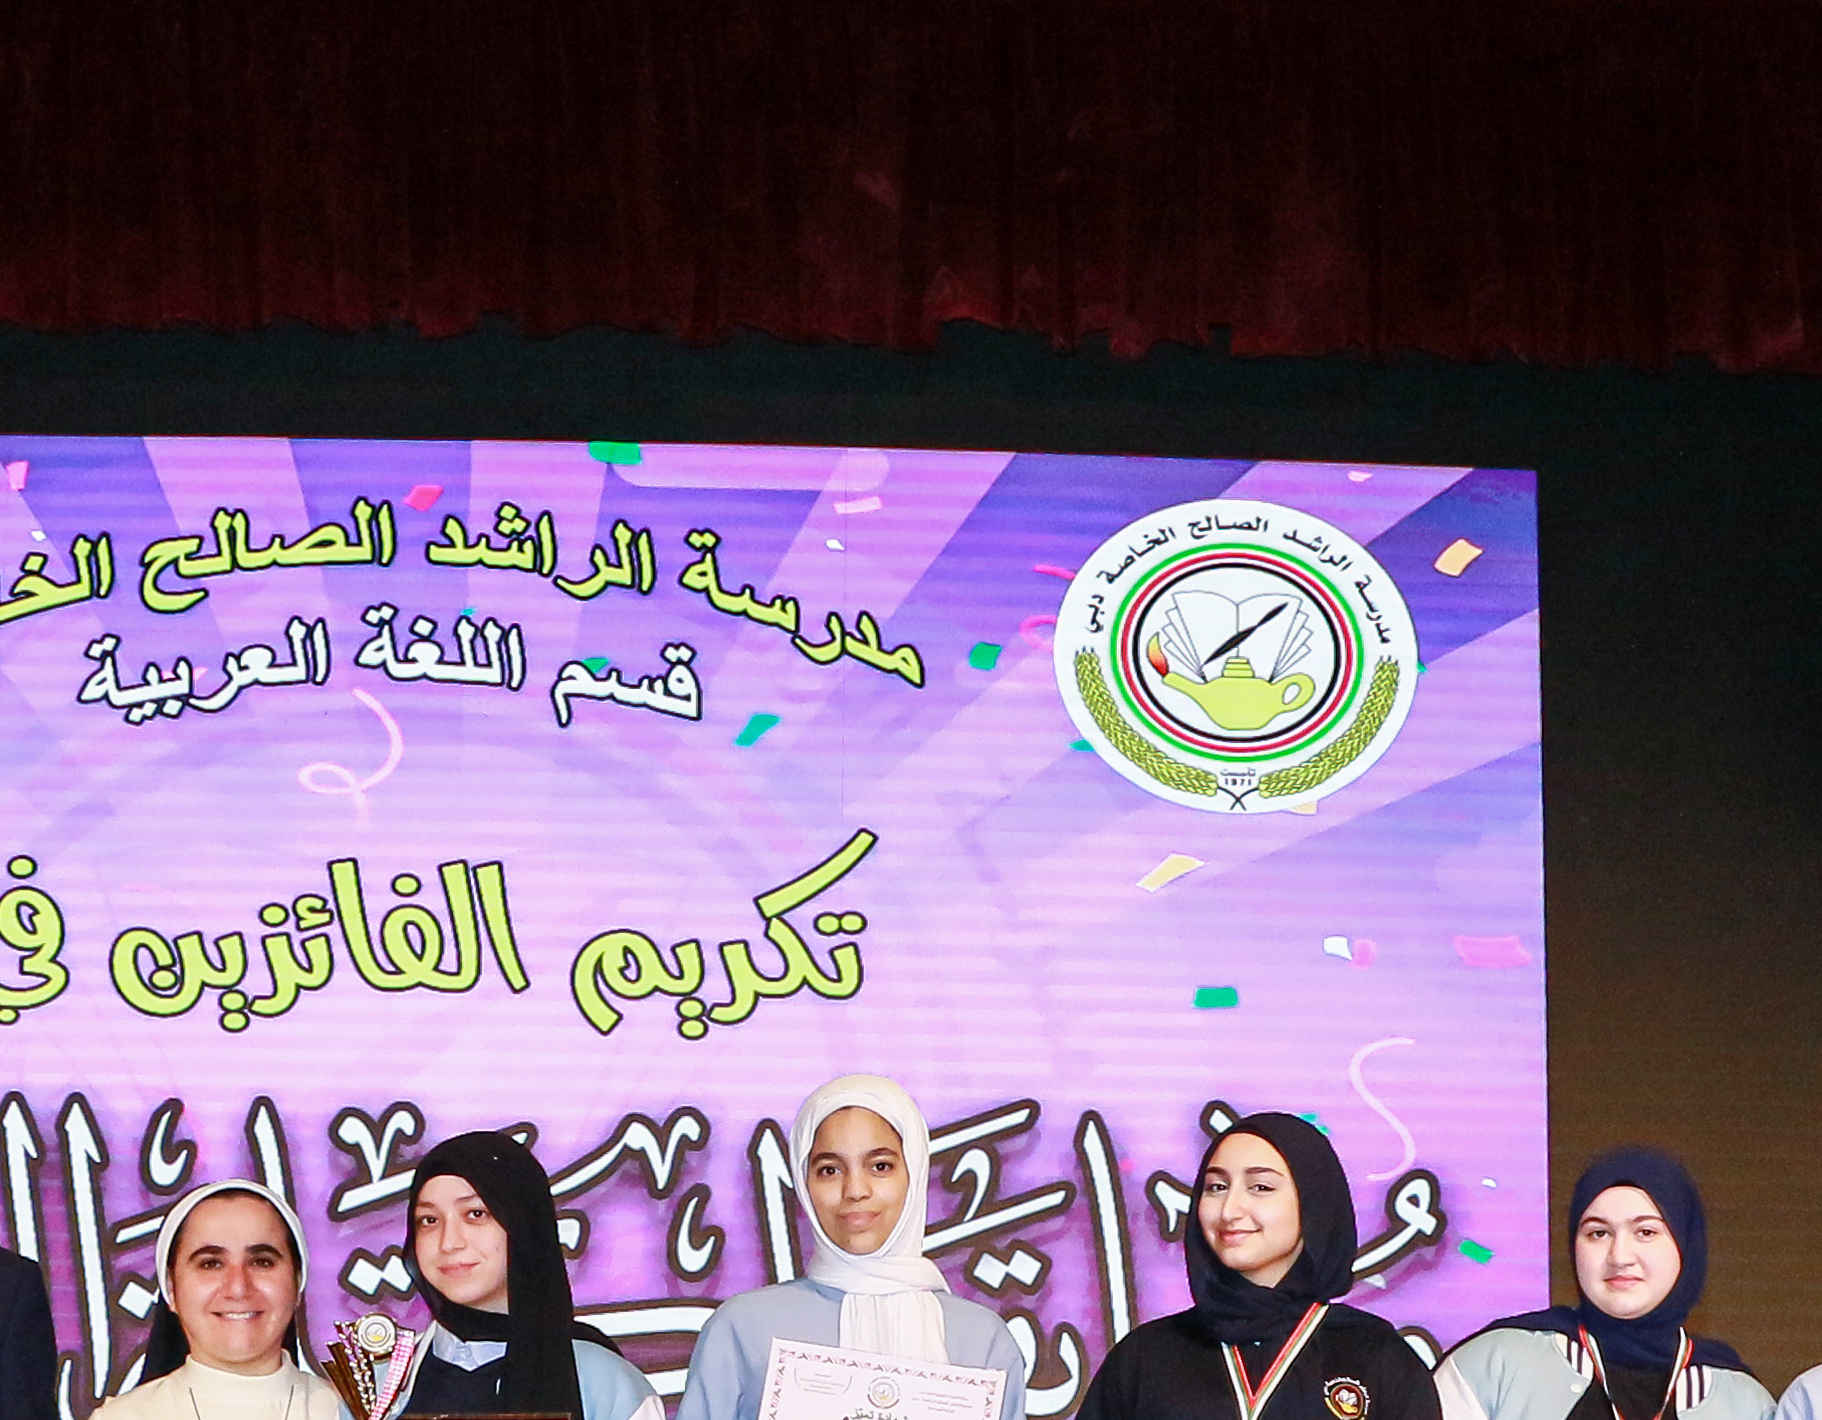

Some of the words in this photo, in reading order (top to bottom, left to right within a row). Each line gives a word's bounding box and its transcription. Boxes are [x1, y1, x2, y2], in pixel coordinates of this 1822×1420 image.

[140, 498, 395, 614] الصالح
[426, 502, 656, 600] الراشد
[1096, 526, 1177, 585] الخاصة
[1187, 513, 1270, 540] الصالح
[1281, 528, 1353, 573] الراشد
[355, 603, 524, 692] اللغة
[678, 526, 929, 687] مدرسة
[1086, 593, 1106, 634] دبي
[1354, 574, 1392, 645] مدرسة
[76, 616, 331, 724] العربية
[551, 644, 704, 727] قسم
[107, 857, 528, 1034] الفائزين
[571, 828, 878, 1038] تكريم
